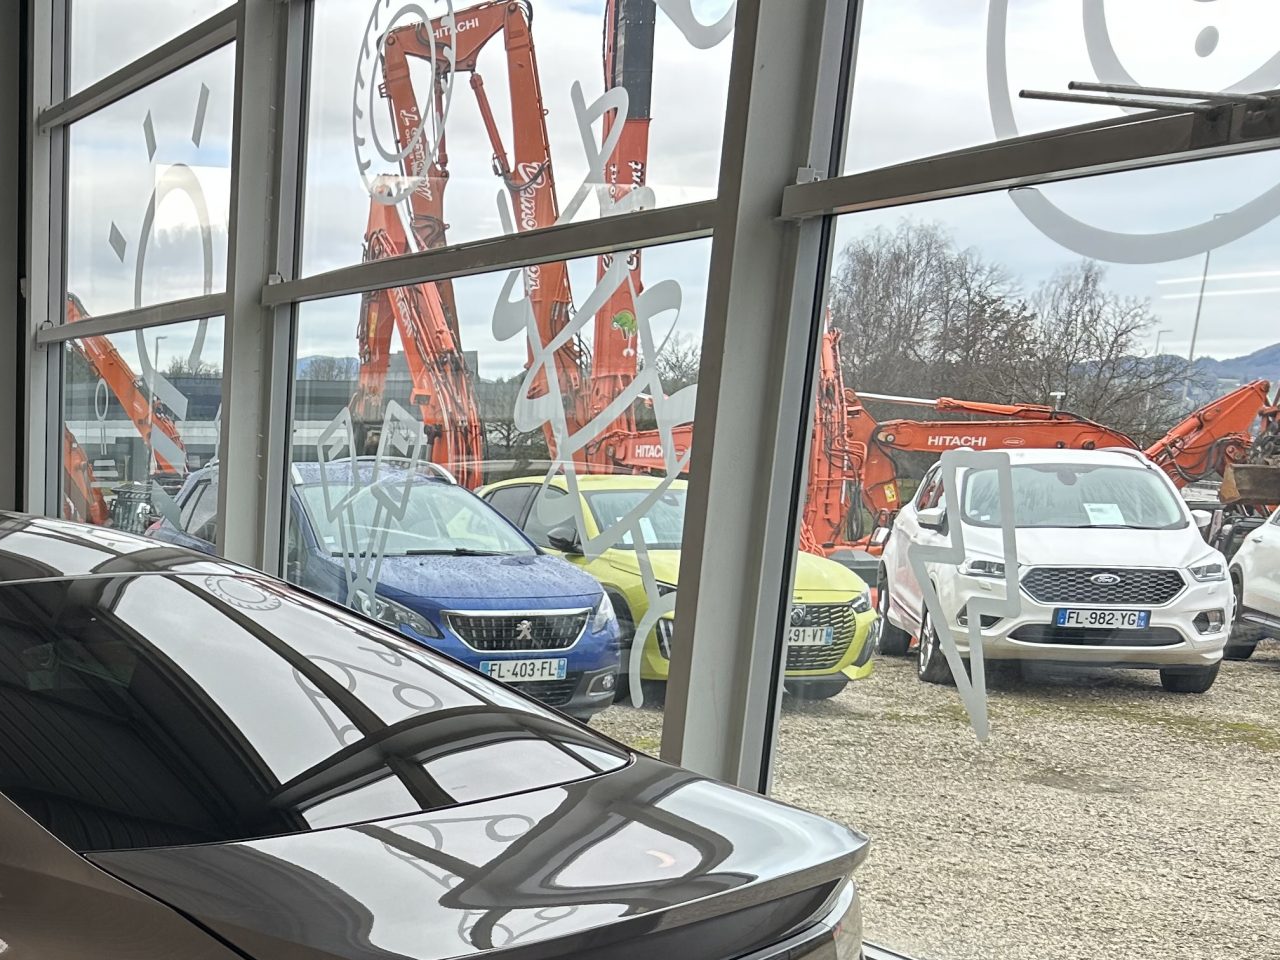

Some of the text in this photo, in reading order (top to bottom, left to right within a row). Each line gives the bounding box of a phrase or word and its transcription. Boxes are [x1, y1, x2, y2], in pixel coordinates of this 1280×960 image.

[928, 435, 987, 447] HITACHI
[1066, 611, 1137, 625] FL-982-YG
[489, 661, 556, 678] FL-403-FL
